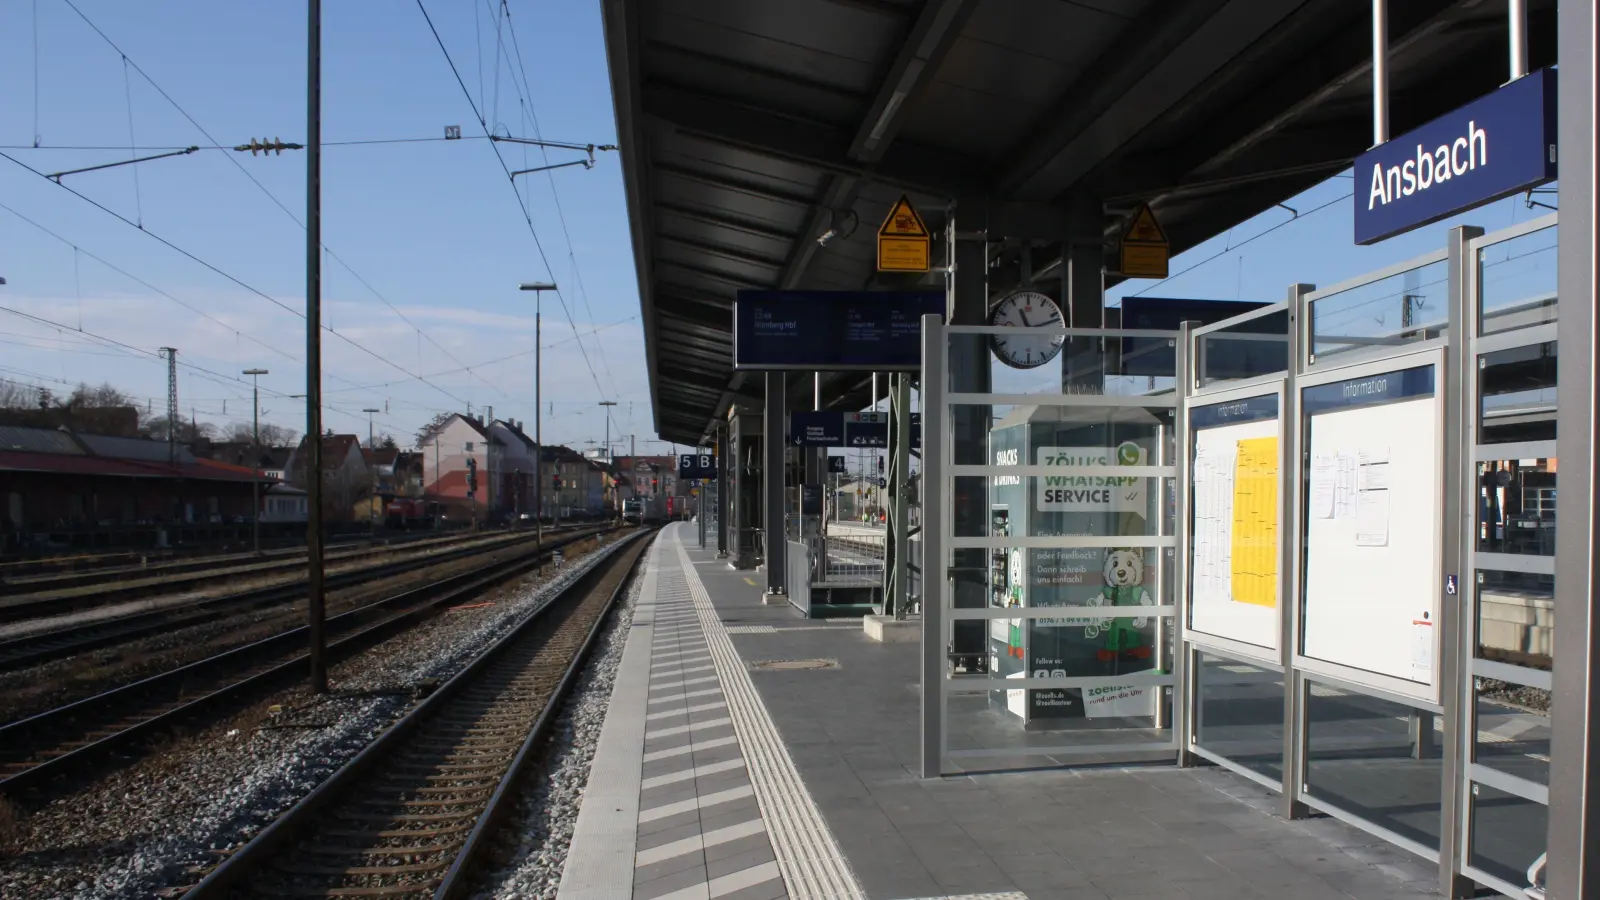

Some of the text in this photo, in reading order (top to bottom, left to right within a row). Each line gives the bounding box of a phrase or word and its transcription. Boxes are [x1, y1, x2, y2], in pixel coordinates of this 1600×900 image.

[1368, 120, 1487, 210] Ansbach
[1342, 379, 1387, 397] Information
[1217, 402, 1248, 417] Information
[683, 456, 691, 468] 5
[700, 456, 710, 468] B
[996, 448, 1018, 466] SNACKS
[834, 457, 843, 470] 4
[1045, 475, 1138, 487] WHATSAPP
[1045, 489, 1110, 503] SERVICE
[1037, 551, 1055, 559] oder
[1037, 565, 1087, 573] Dann schreib
[1037, 574, 1083, 584] uns einfach!
[1035, 657, 1054, 665] Follow
[1089, 695, 1105, 704] rund
[1118, 691, 1129, 699] die
